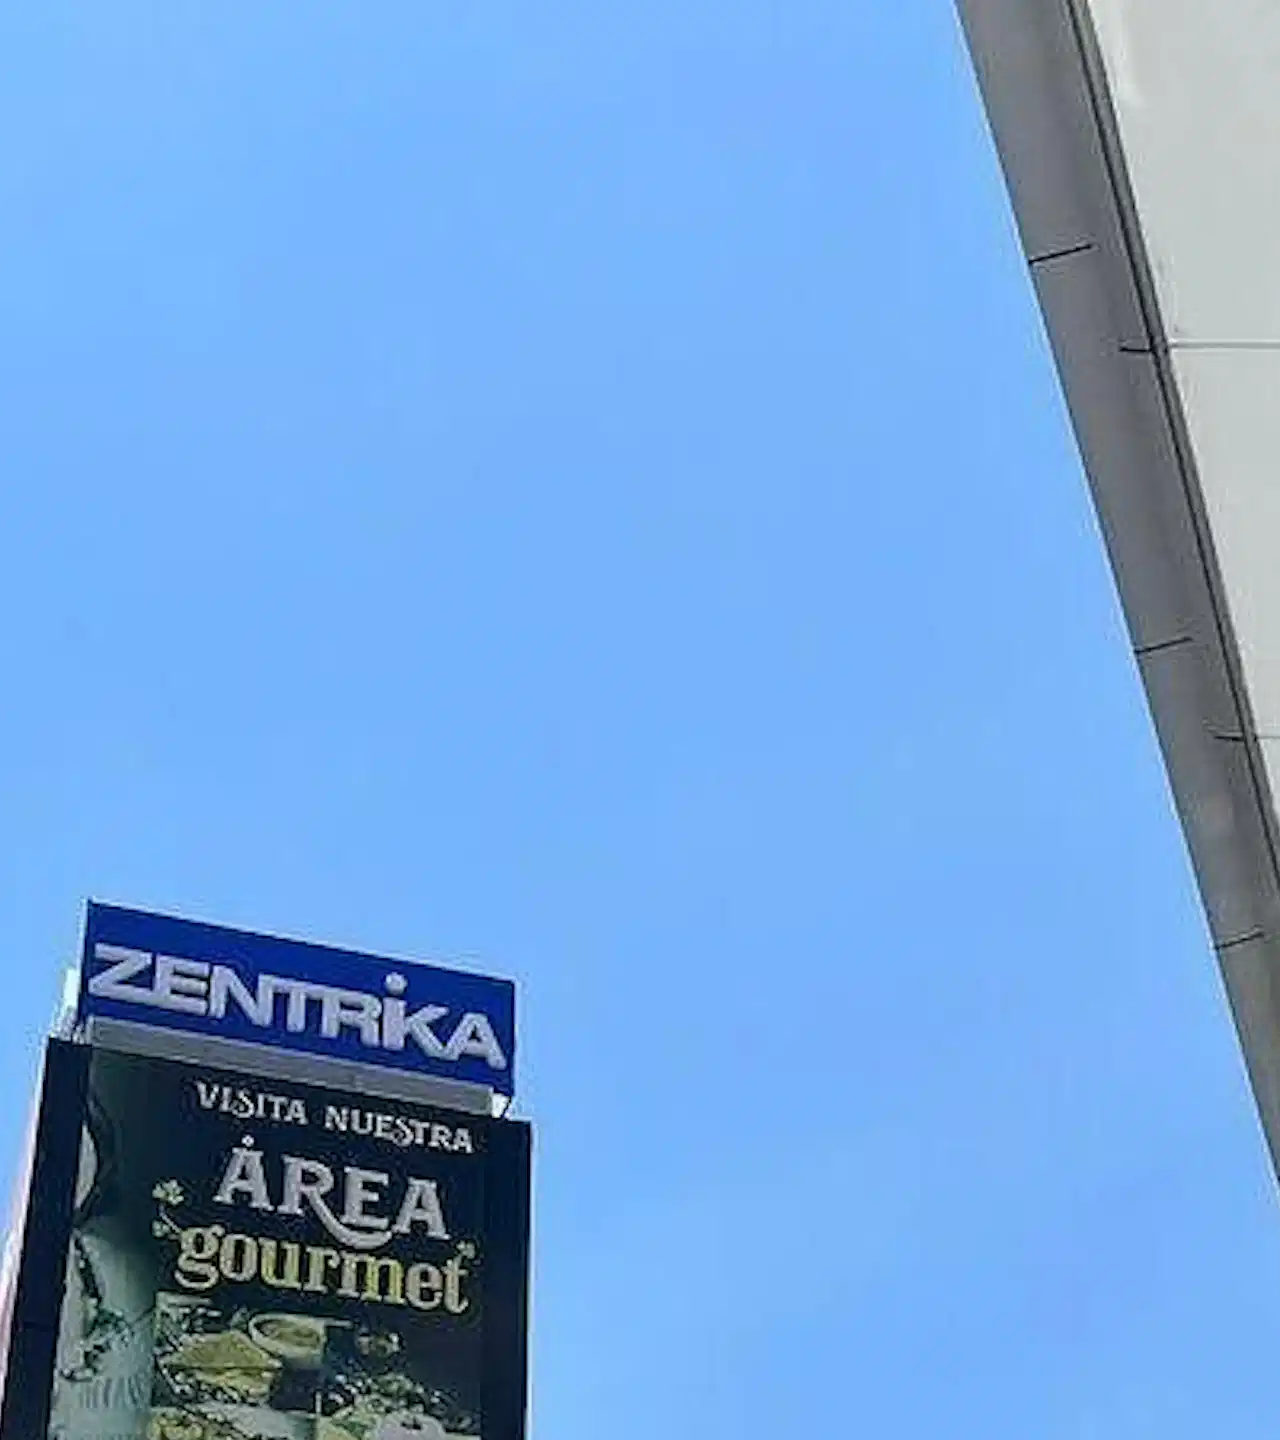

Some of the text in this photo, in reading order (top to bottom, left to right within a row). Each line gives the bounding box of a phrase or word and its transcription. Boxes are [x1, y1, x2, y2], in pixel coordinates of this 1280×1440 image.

[196, 1080, 474, 1153] VISITA NUESTRA
[173, 1225, 471, 1314] gourmet
